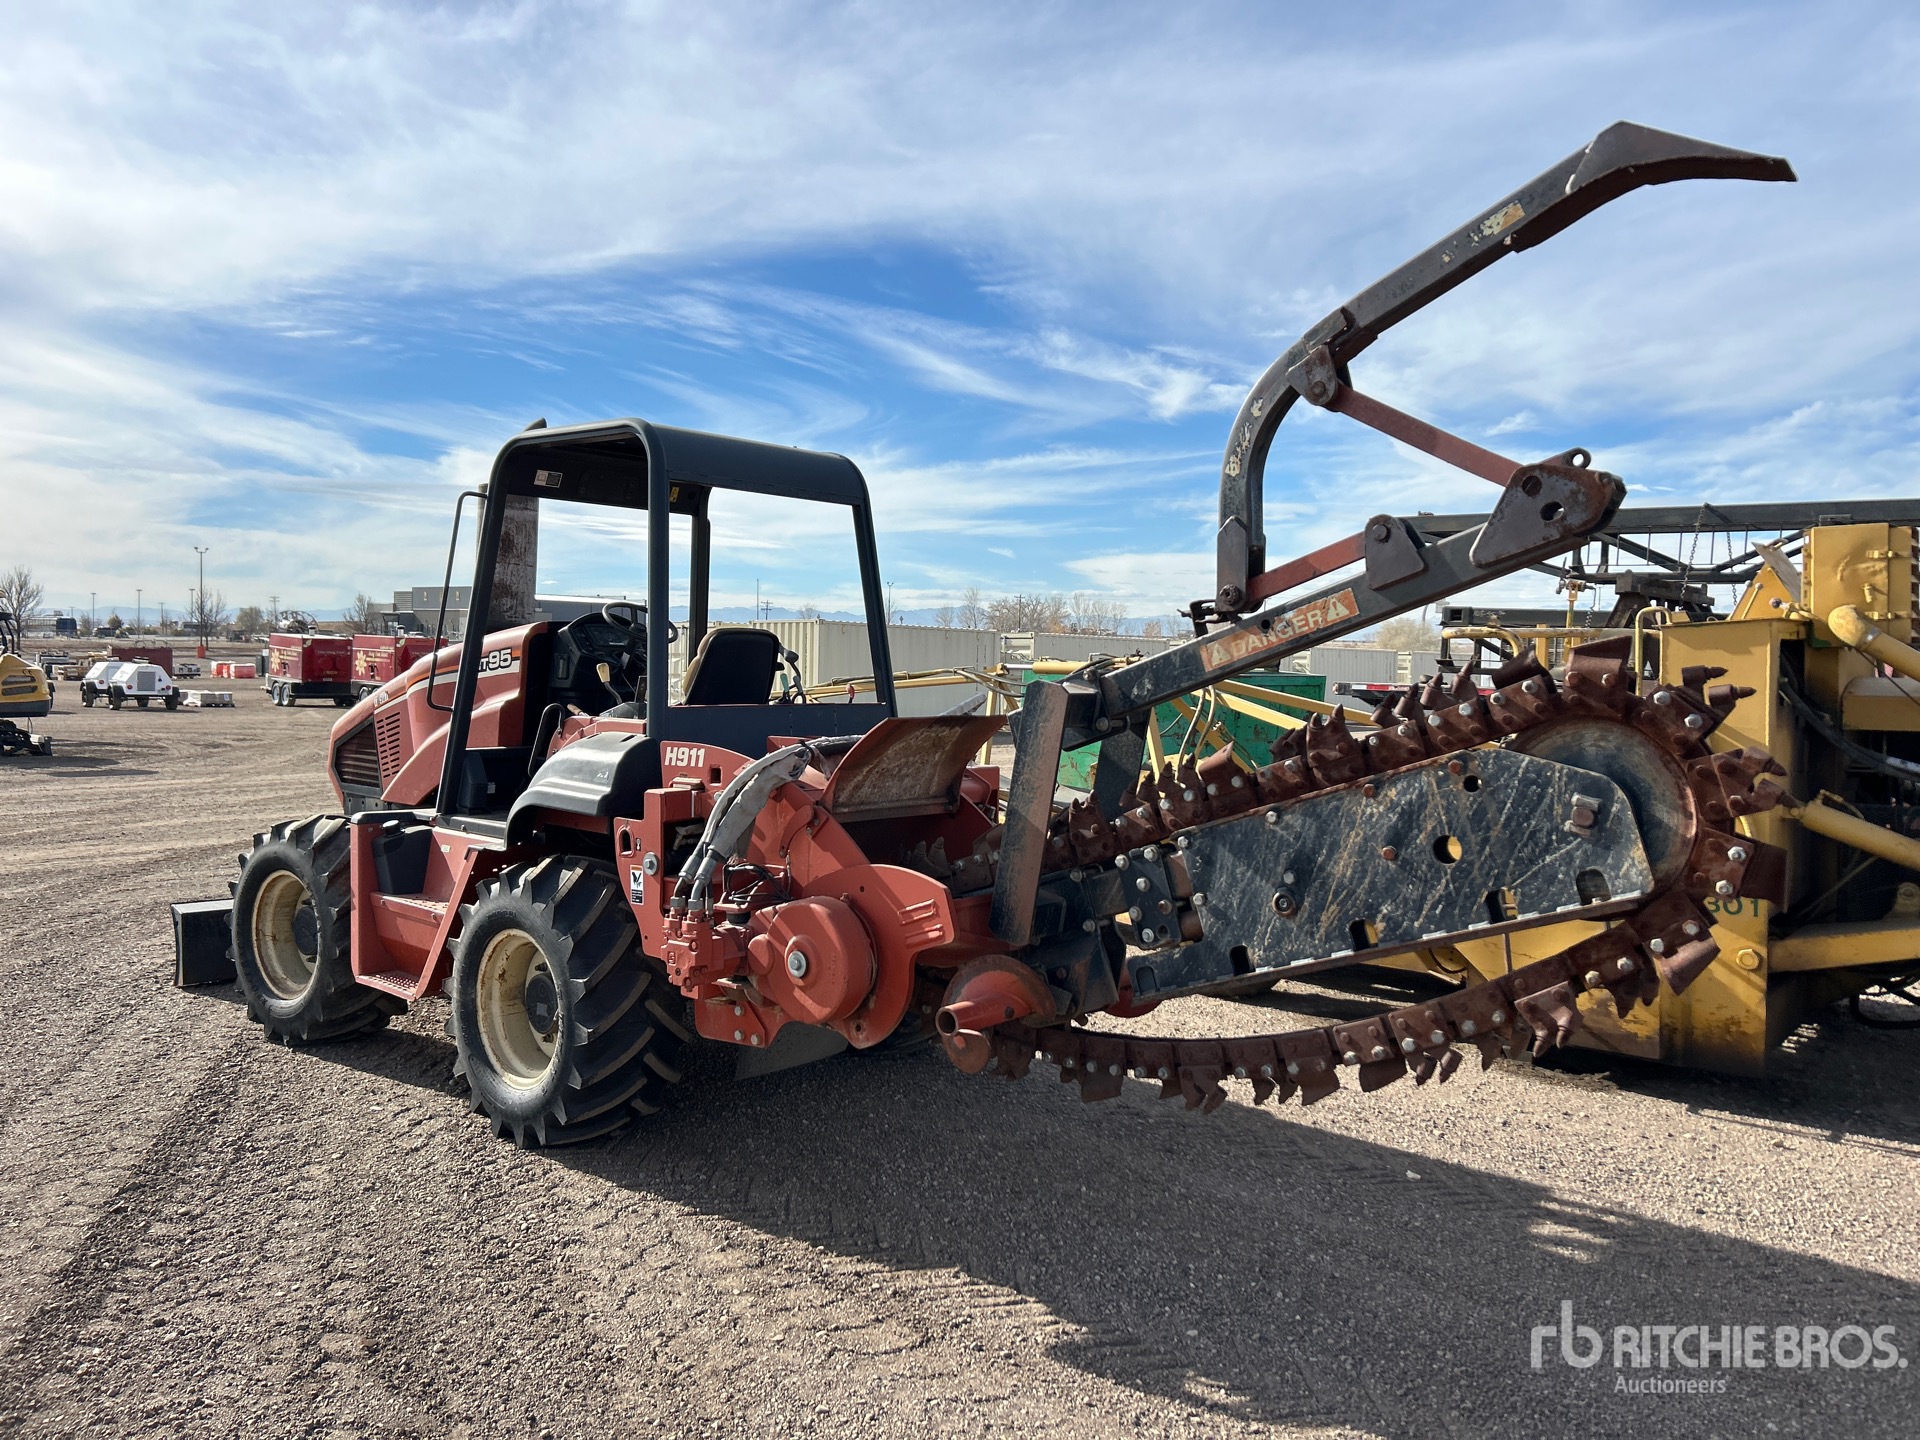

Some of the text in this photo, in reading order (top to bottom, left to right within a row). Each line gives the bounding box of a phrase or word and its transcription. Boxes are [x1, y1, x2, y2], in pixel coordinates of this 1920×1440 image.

[1231, 609, 1323, 656] DANGER
[479, 649, 512, 671] T95
[664, 746, 705, 768] H911
